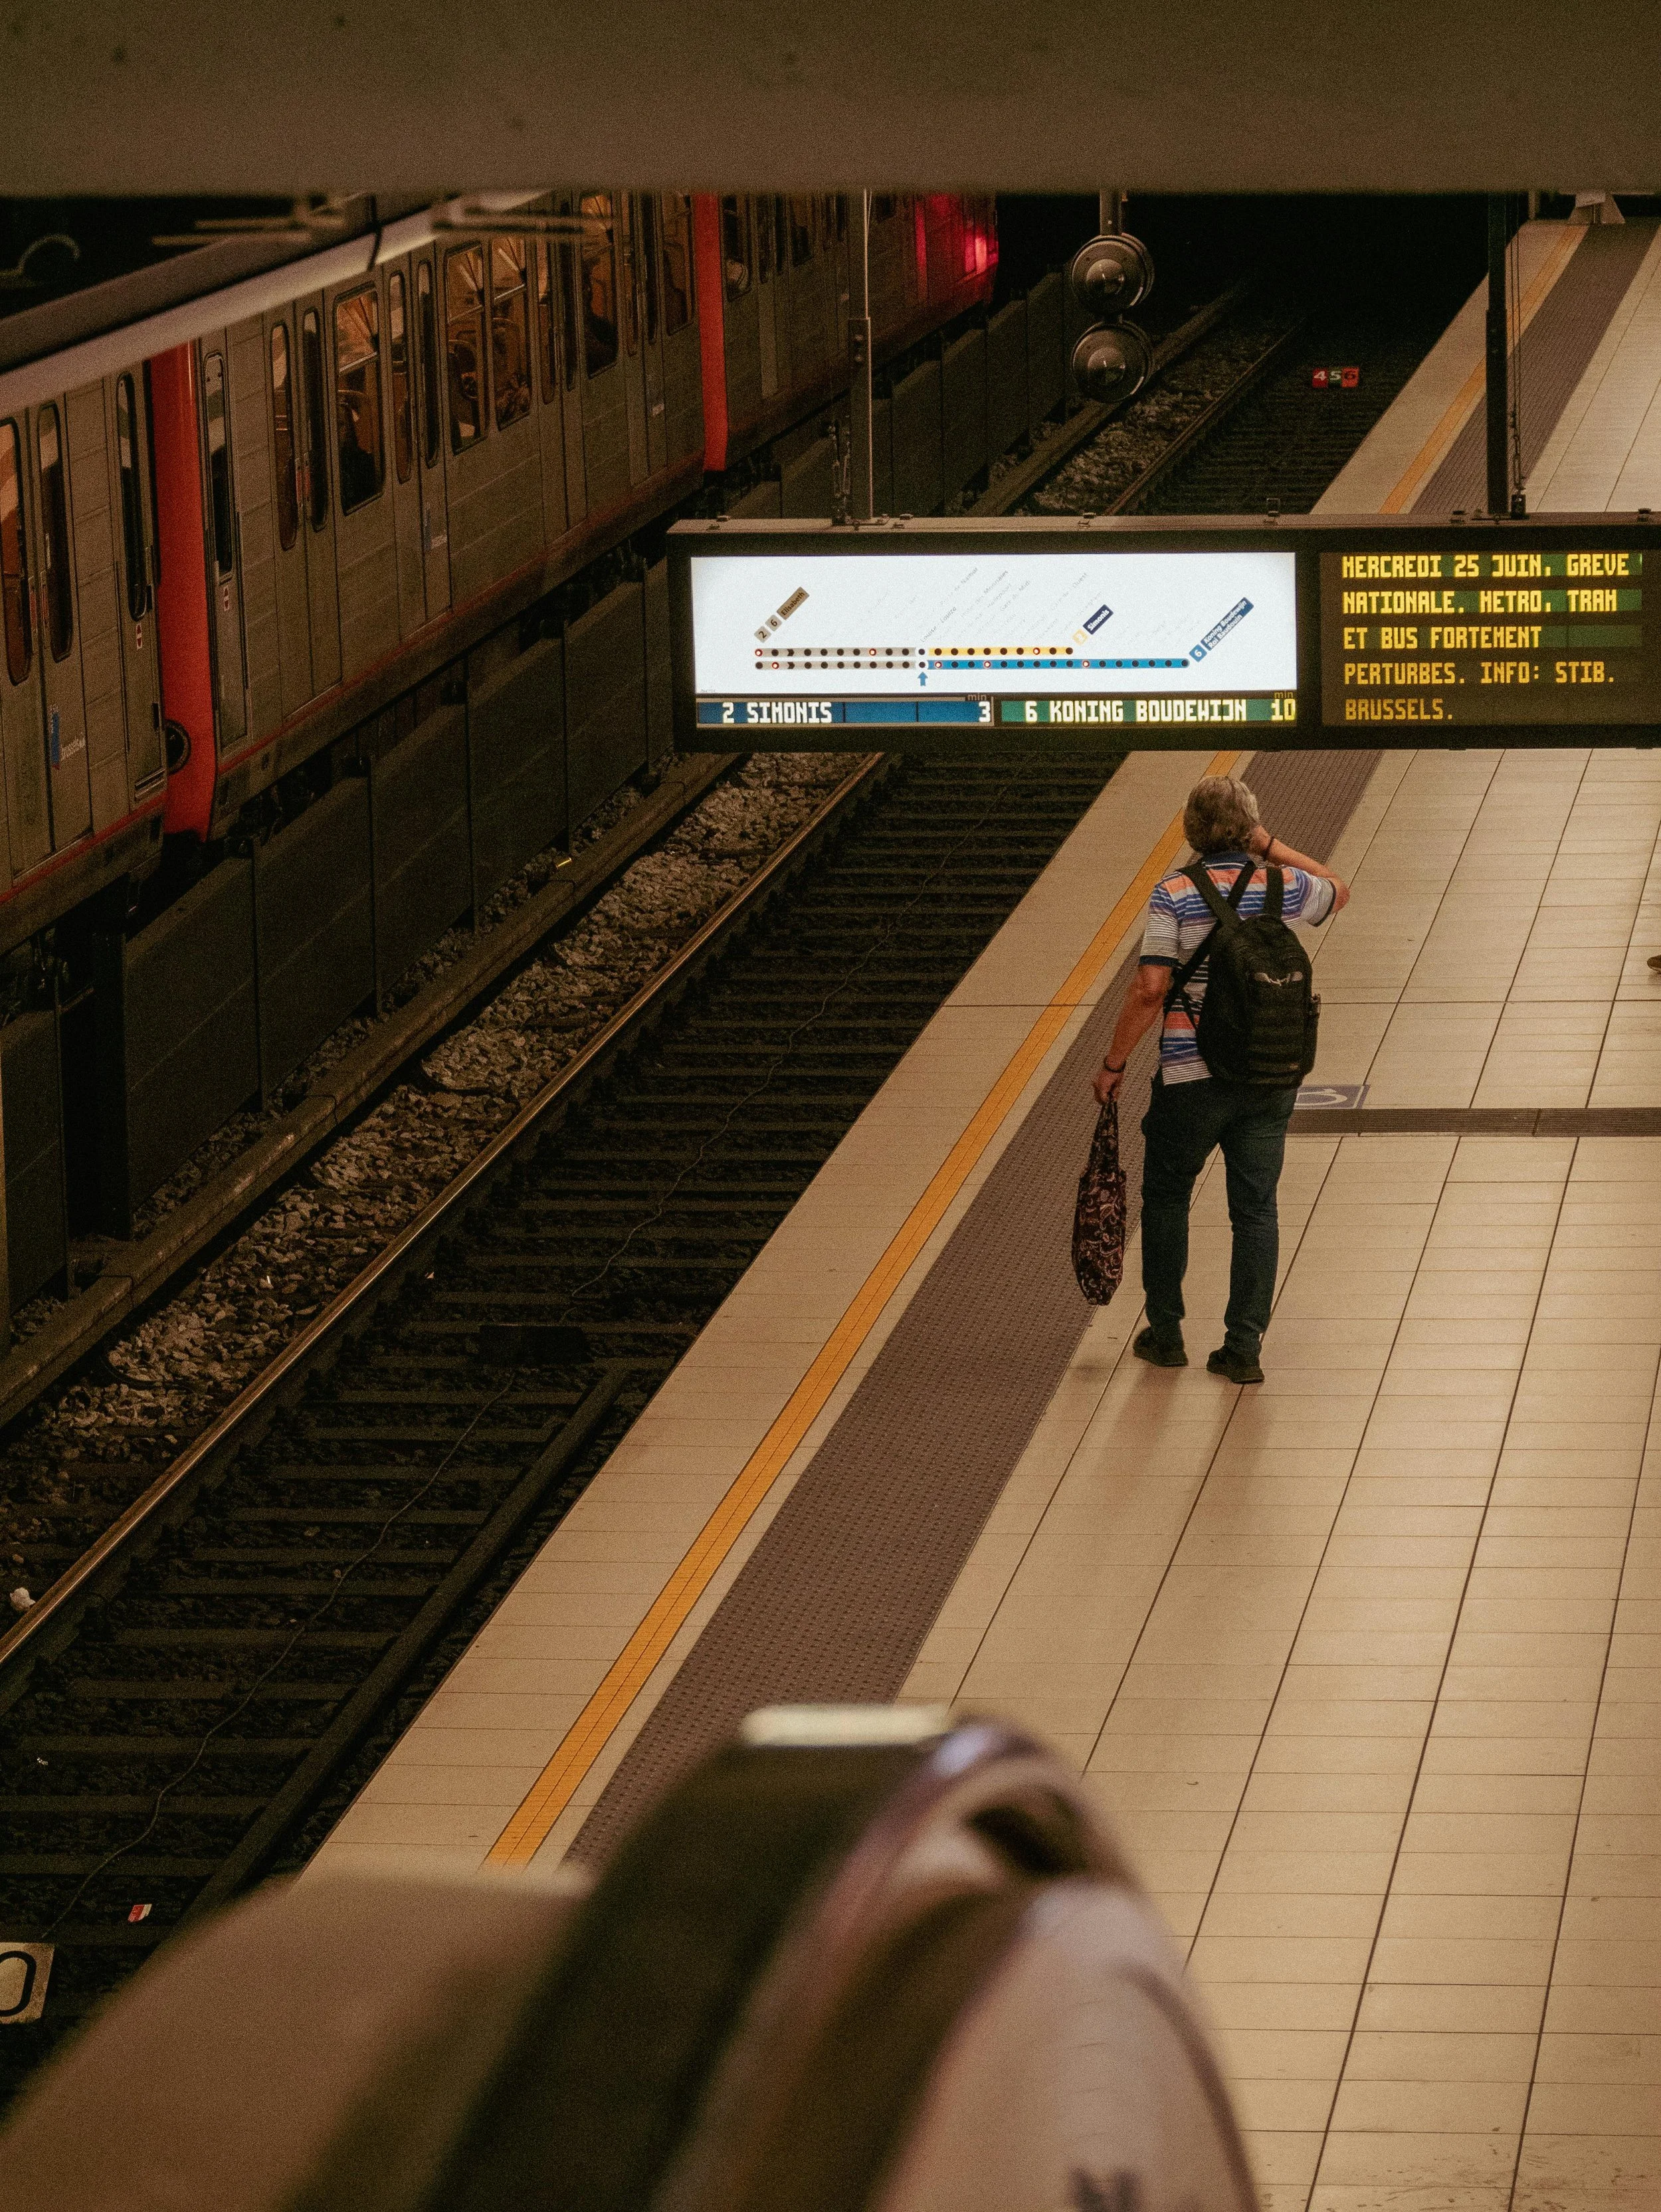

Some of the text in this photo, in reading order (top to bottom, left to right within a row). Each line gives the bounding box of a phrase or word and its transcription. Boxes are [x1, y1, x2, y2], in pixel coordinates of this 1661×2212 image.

[1314, 371, 1327, 381] 4
[1329, 371, 1341, 380] 5
[1342, 555, 1442, 578] MERCREDI
[1454, 555, 1479, 577] 25
[1567, 553, 1629, 576] GREVE
[781, 592, 805, 615] Elisabeth
[1343, 591, 1464, 614] NATIONALE.
[1567, 589, 1616, 612] TRAM
[1087, 609, 1110, 631] Simonis
[1203, 625, 1223, 645] Koning
[1220, 600, 1247, 627] Boudewijn
[1208, 637, 1219, 648] Roi
[1344, 626, 1542, 650] ET BUS FORTEMENT
[1345, 662, 1614, 685] PERTURBES. INFO: STIB.
[722, 701, 991, 724] 2 SIMONIS 3
[1025, 698, 1296, 723] 6 KONING BOUDEWIJN 10
[1345, 698, 1453, 720] BRUSSELS.
